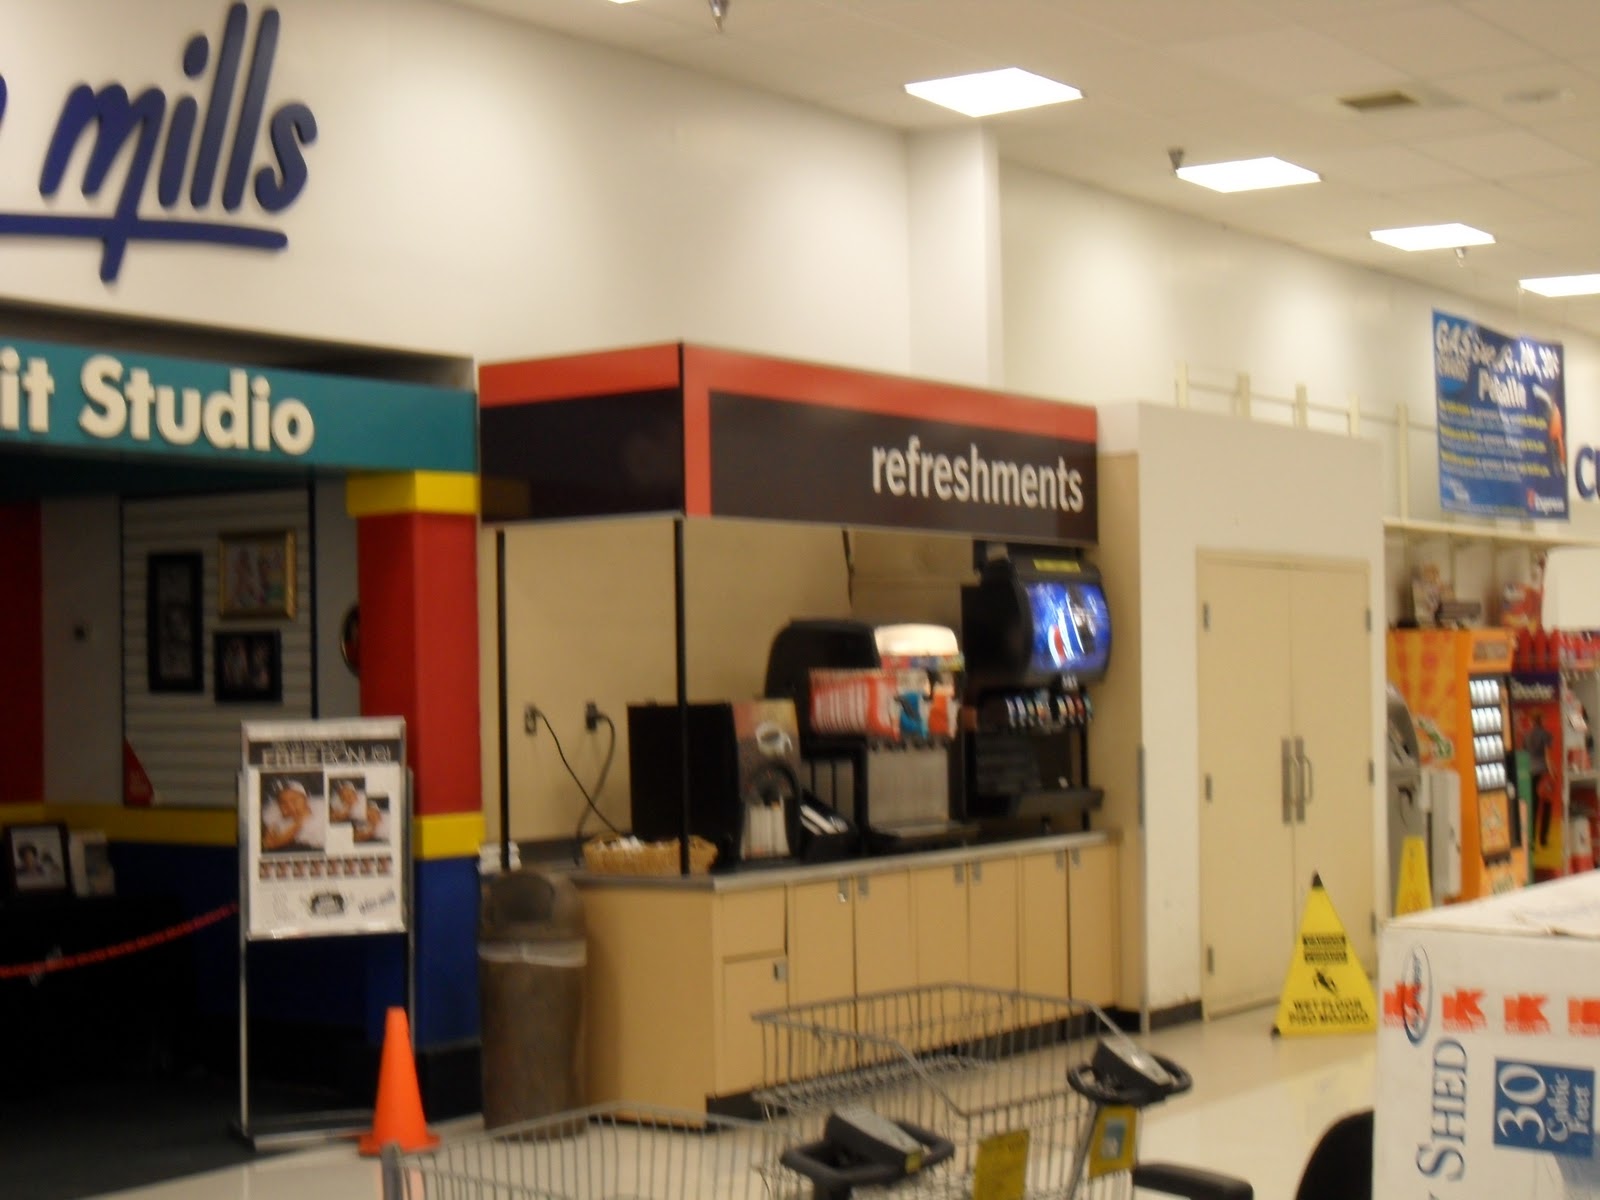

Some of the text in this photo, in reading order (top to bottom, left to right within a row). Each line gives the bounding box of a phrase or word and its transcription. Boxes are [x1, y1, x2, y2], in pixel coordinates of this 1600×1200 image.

[39, 2, 318, 283] mills
[79, 355, 315, 455] Studio
[872, 434, 1084, 513] refreshments
[1416, 1036, 1468, 1182] SHED
[1497, 1062, 1548, 1145] 30
